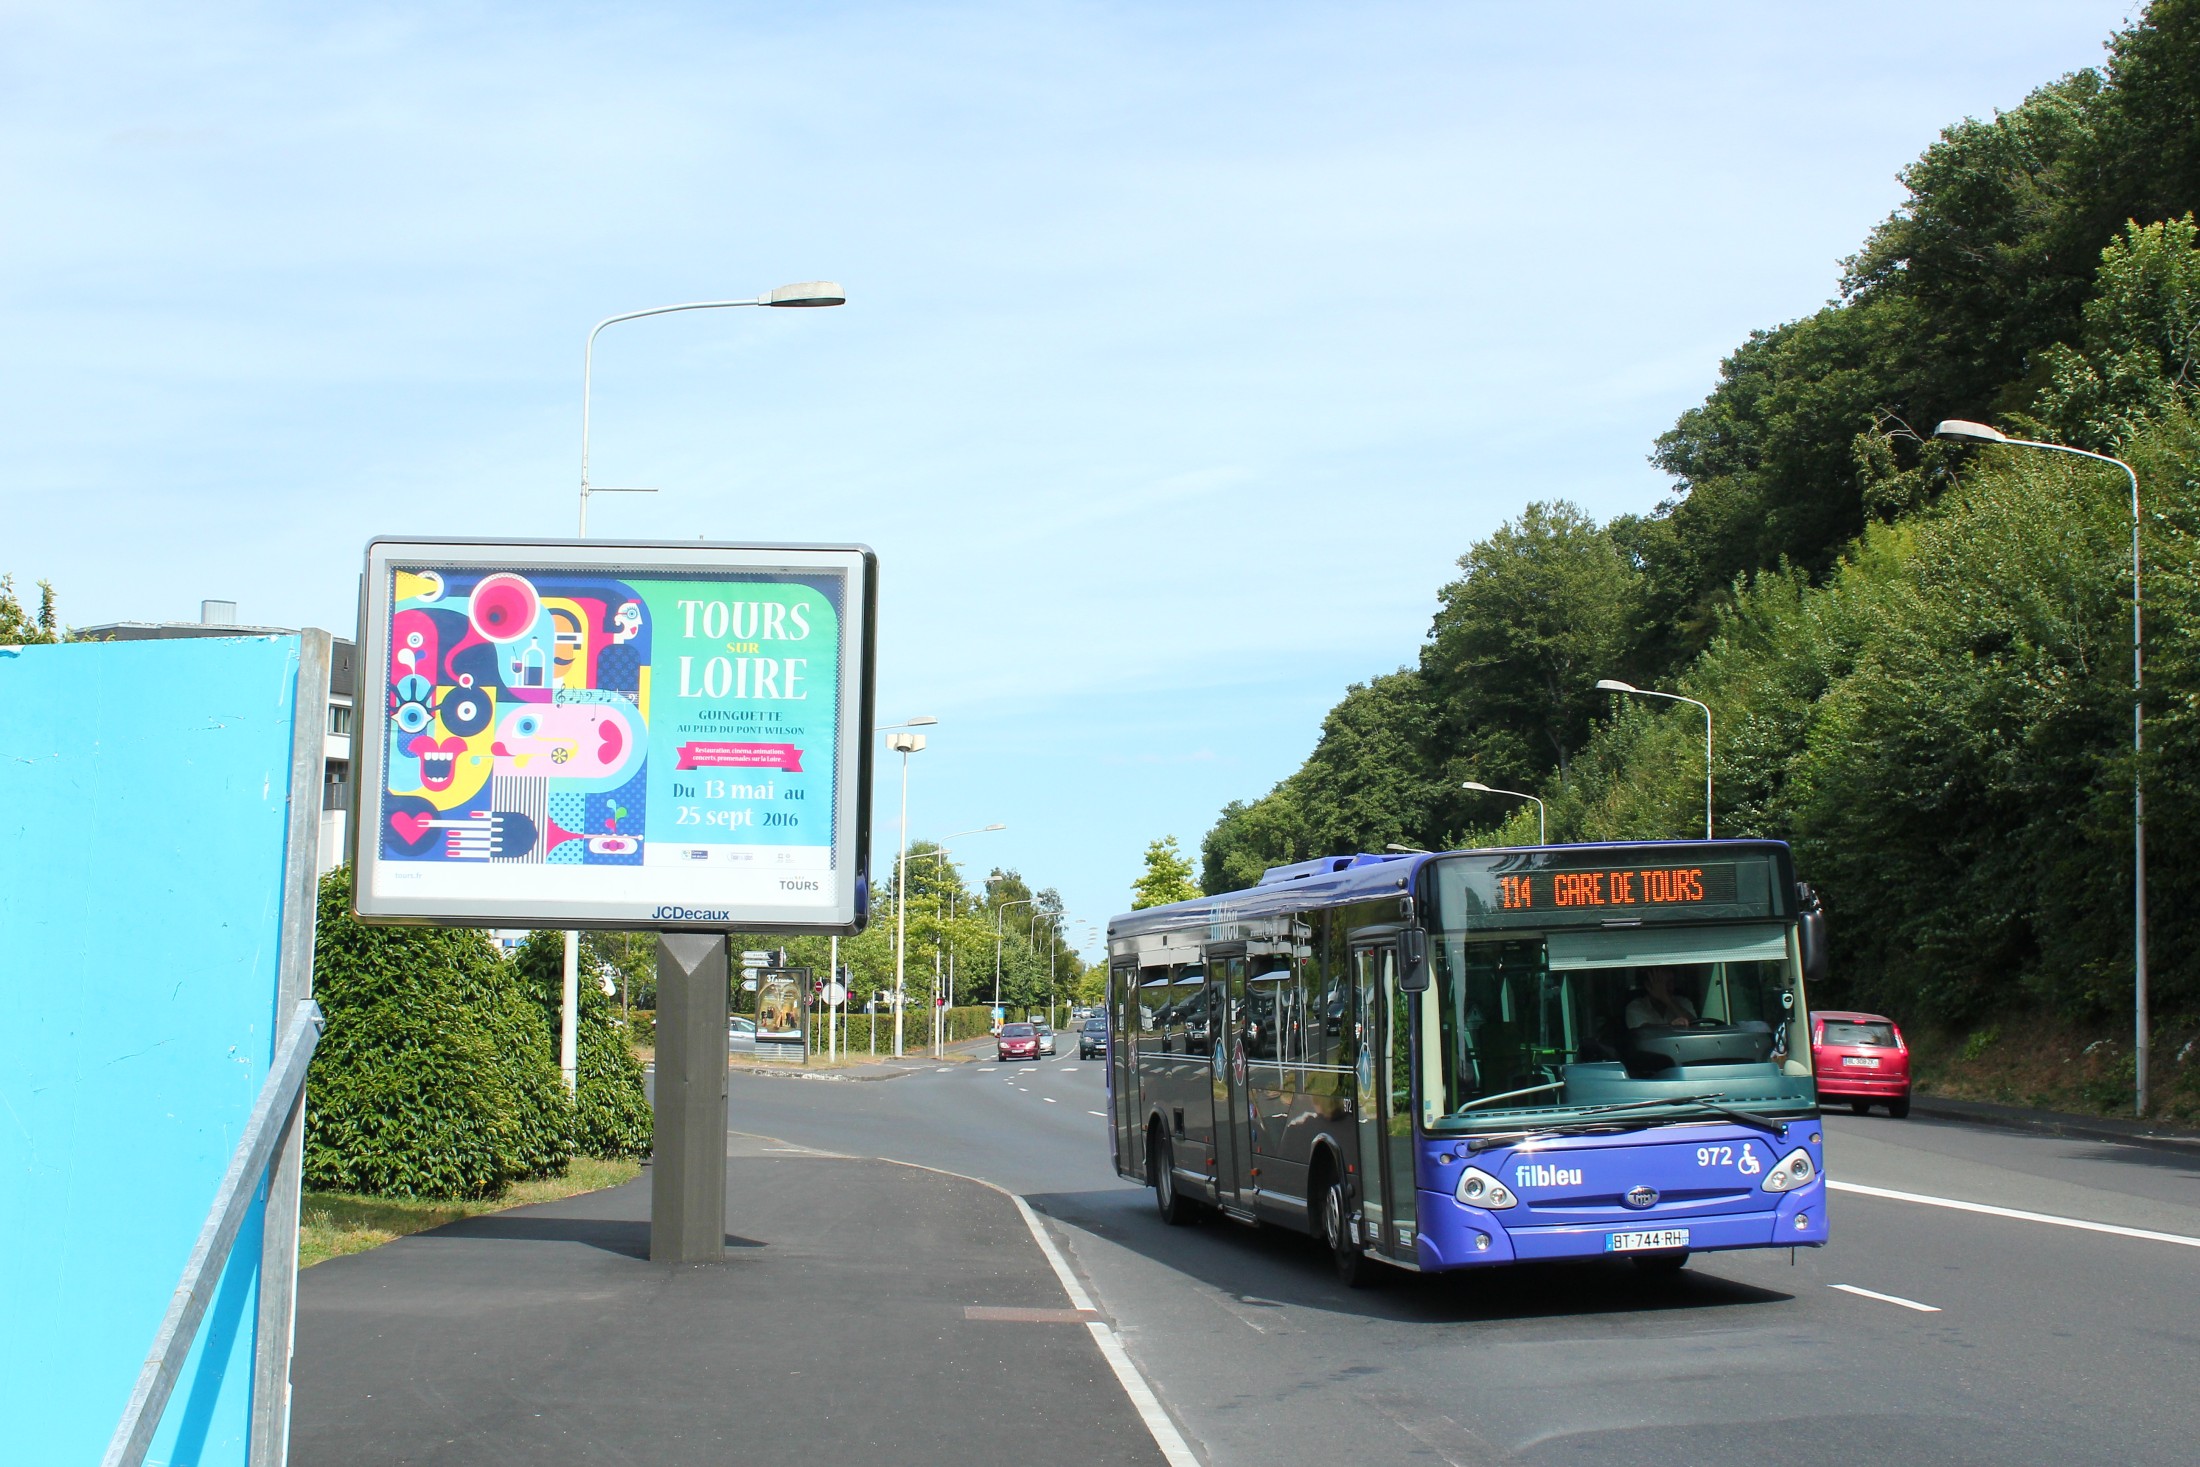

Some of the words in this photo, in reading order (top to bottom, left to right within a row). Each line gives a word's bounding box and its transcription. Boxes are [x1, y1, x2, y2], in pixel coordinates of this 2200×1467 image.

[677, 599, 811, 641] TOURS
[726, 642, 760, 654] SUR
[677, 656, 808, 700] LOIRE
[698, 710, 783, 722] GUINGUETTE
[676, 724, 692, 733] AU
[693, 725, 718, 734] PIED
[719, 726, 736, 734] DU
[737, 726, 764, 735] PONT
[765, 726, 805, 736] WILSON
[717, 755, 751, 763] promenades
[673, 783, 696, 799] Du
[704, 780, 725, 799] 13
[731, 780, 775, 801] mai
[784, 788, 805, 801] au
[676, 806, 701, 826] 25
[706, 808, 755, 831] sept
[762, 812, 799, 827] 2016
[779, 880, 819, 891] TOURS
[1500, 875, 1533, 909] 114
[1554, 872, 1605, 907] GARE
[1610, 871, 1635, 905] DE
[1640, 868, 1703, 903] TOURS
[652, 906, 730, 921] JCDecaux
[1343, 1098, 1353, 1114] 972
[1696, 1146, 1733, 1167] 972
[1516, 1164, 1583, 1188] filbleu
[1613, 1230, 1682, 1250] BT-744-RH
